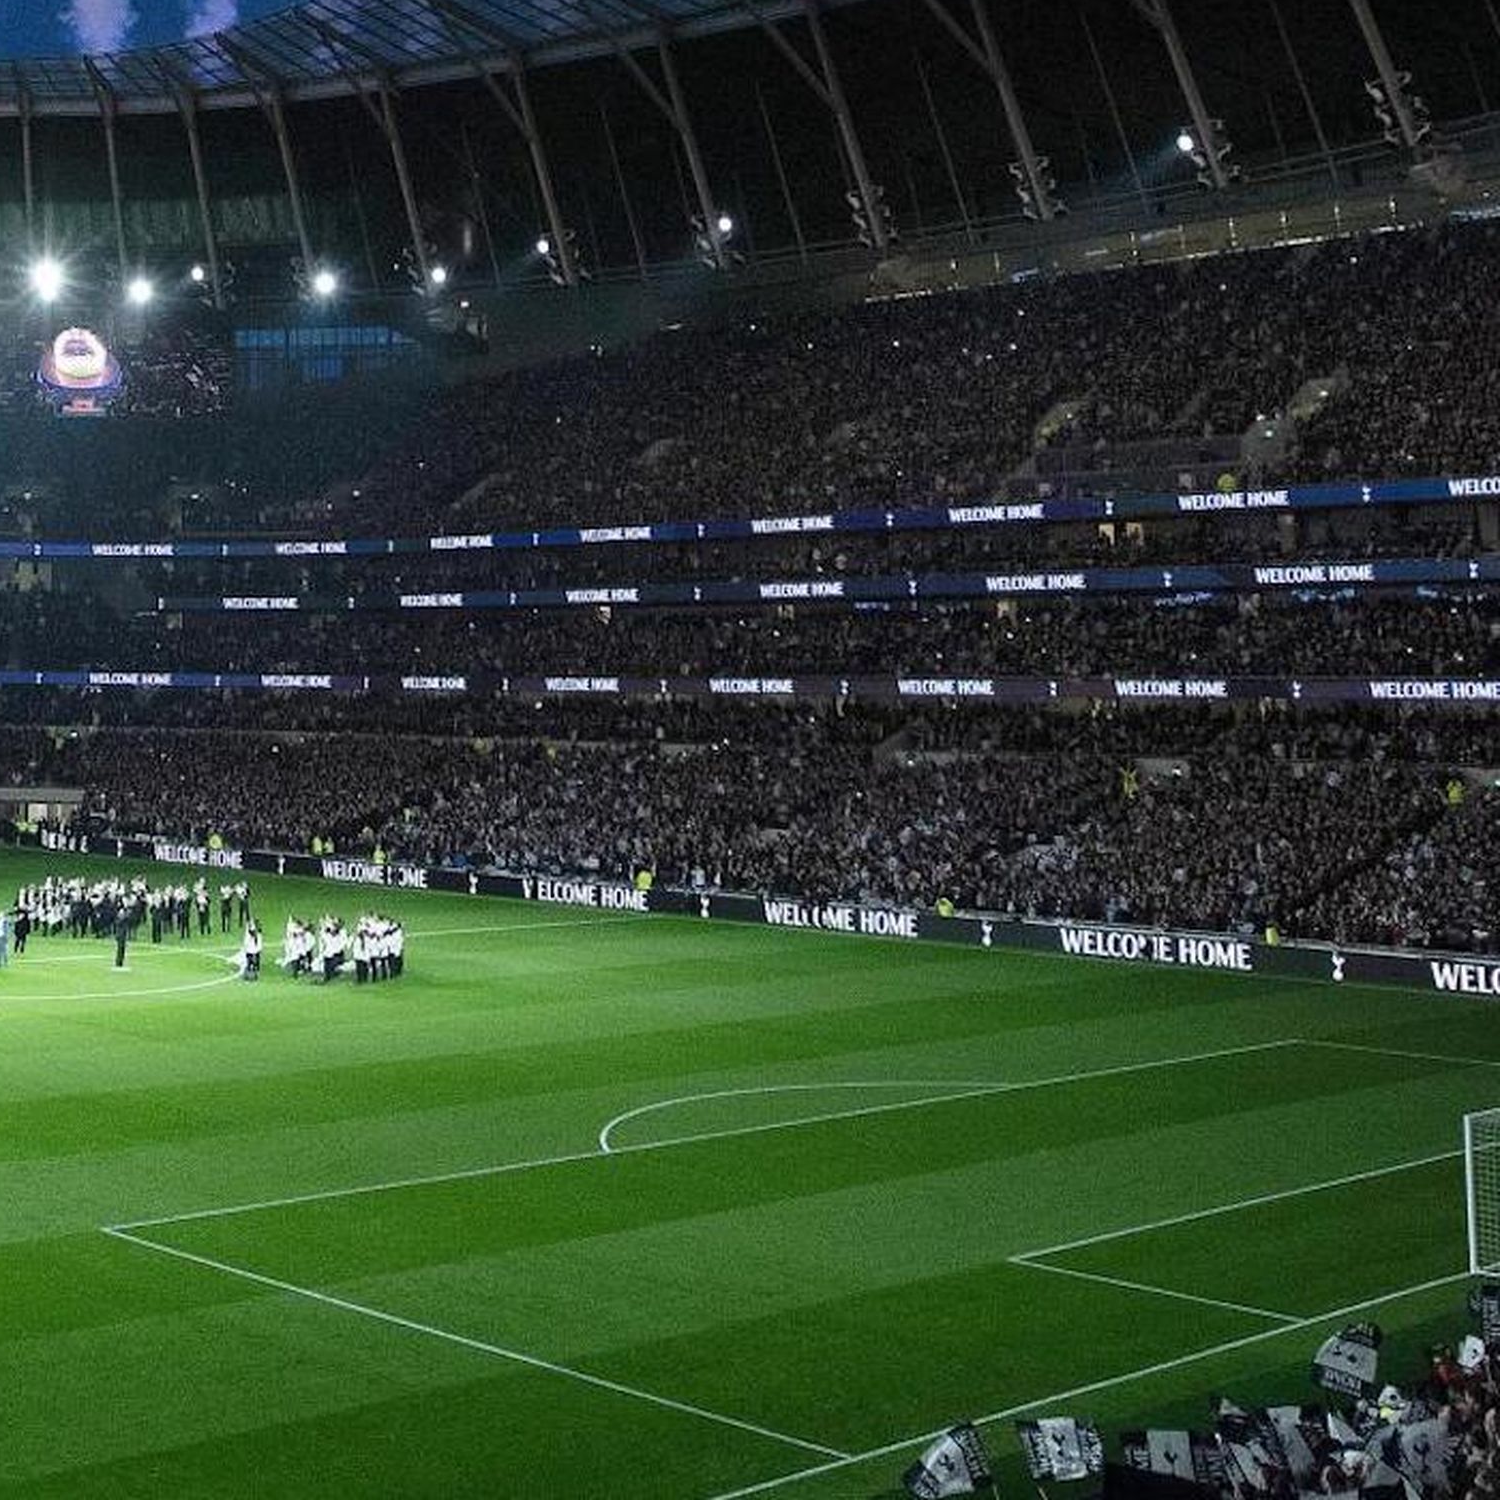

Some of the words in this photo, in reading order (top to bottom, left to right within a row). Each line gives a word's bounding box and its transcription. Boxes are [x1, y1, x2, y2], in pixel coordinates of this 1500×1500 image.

[1179, 493, 1244, 510] WELCOME
[1246, 490, 1289, 507] HOME
[949, 507, 1005, 522] WELCOME
[1006, 504, 1043, 520] HOME
[752, 517, 800, 533] WELCOME
[801, 515, 834, 530] HOME
[430, 536, 469, 549] WELCOME
[470, 535, 493, 548] HOME
[580, 527, 624, 542] WELCOME
[625, 526, 651, 540] HOME
[92, 544, 141, 556] WELCOME
[144, 545, 174, 556] HOME
[276, 542, 320, 554] WELCOME
[321, 542, 347, 554] HOME
[986, 575, 1047, 591] WELCOME
[1048, 574, 1086, 590] HOME
[1255, 566, 1327, 584] WELCOME
[1328, 564, 1374, 581] HOME
[566, 590, 609, 603] WELCOME
[610, 588, 639, 602] HOME
[760, 583, 809, 598] WELCOME
[810, 581, 843, 596] HOME
[223, 597, 269, 610] WELCOME
[270, 597, 298, 609] HOME
[400, 594, 437, 607] WELCOME
[438, 593, 462, 607] HOME
[90, 673, 138, 685] WELCOME
[140, 673, 171, 686] HOME
[261, 674, 302, 687] WELCOME
[303, 675, 331, 688] HOME
[401, 677, 440, 690] WELCOME
[442, 677, 466, 690] HOME
[546, 677, 590, 691] WELCOME
[591, 678, 618, 691] HOME
[709, 678, 760, 693] WELCOME
[761, 679, 793, 693] HOME
[898, 679, 956, 695] WELCOME
[957, 679, 995, 696] HOME
[1115, 680, 1182, 696] WELCOME
[1184, 681, 1228, 697] HOME
[1370, 681, 1450, 698] WELCOME
[1451, 681, 1500, 699] HOME
[154, 844, 209, 865] WELCOME
[322, 859, 384, 884] WELCOME
[600, 886, 649, 911] HOME
[860, 909, 917, 938] HOME
[1178, 937, 1252, 971] HOME
